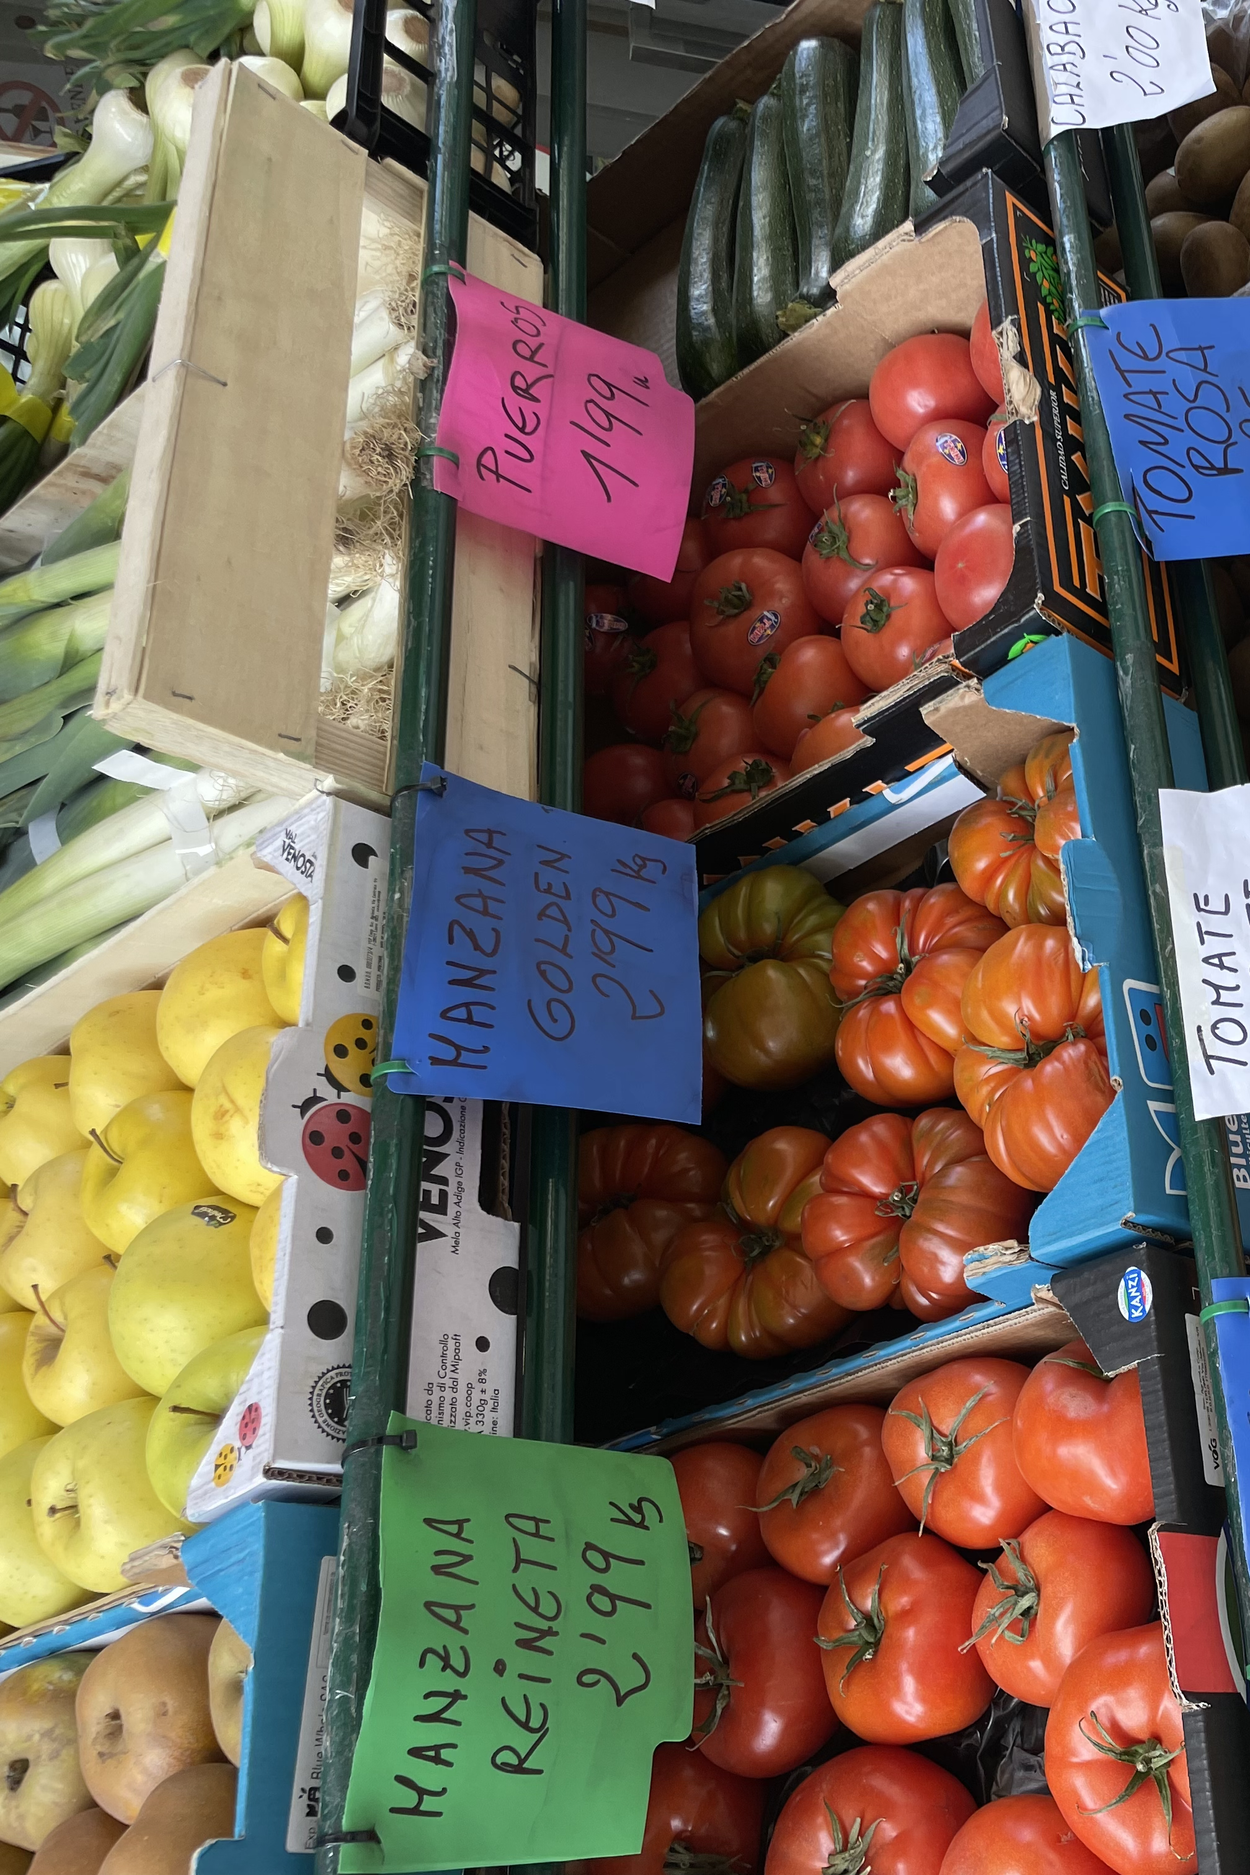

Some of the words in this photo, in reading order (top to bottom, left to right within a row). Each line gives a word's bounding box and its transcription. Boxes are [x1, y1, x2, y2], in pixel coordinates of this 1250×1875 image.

[476, 301, 554, 494] PUERROS
[1050, 389, 1065, 438] SUPERIOR
[1165, 344, 1244, 477] ROSA
[1108, 323, 1196, 533] TOMATE
[1055, 438, 1069, 491] CALIDAD
[281, 839, 317, 884] VENOSTA
[610, 853, 668, 885] Kg
[428, 827, 512, 1071] MANZANA
[527, 844, 576, 1042] GOLDEN
[1192, 891, 1249, 1076] TOMATE
[455, 1105, 468, 1156] Indicazione
[455, 1161, 464, 1180] IGP
[453, 1180, 467, 1209] Adige
[452, 1209, 462, 1230] Alto
[450, 1230, 460, 1256] Mela
[437, 1333, 450, 1380] Controllo
[450, 1333, 463, 1375] Mipaaft
[423, 1382, 434, 1396] da
[436, 1382, 447, 1393] di
[448, 1376, 459, 1394] dal
[477, 1368, 488, 1385] 8%
[435, 1395, 446, 1426] nismo
[475, 1398, 489, 1427] 330g
[490, 1388, 500, 1414] Italia
[608, 1496, 664, 1532] Kg
[576, 1541, 653, 1708] 2'99
[389, 1517, 480, 1818] MANZANA
